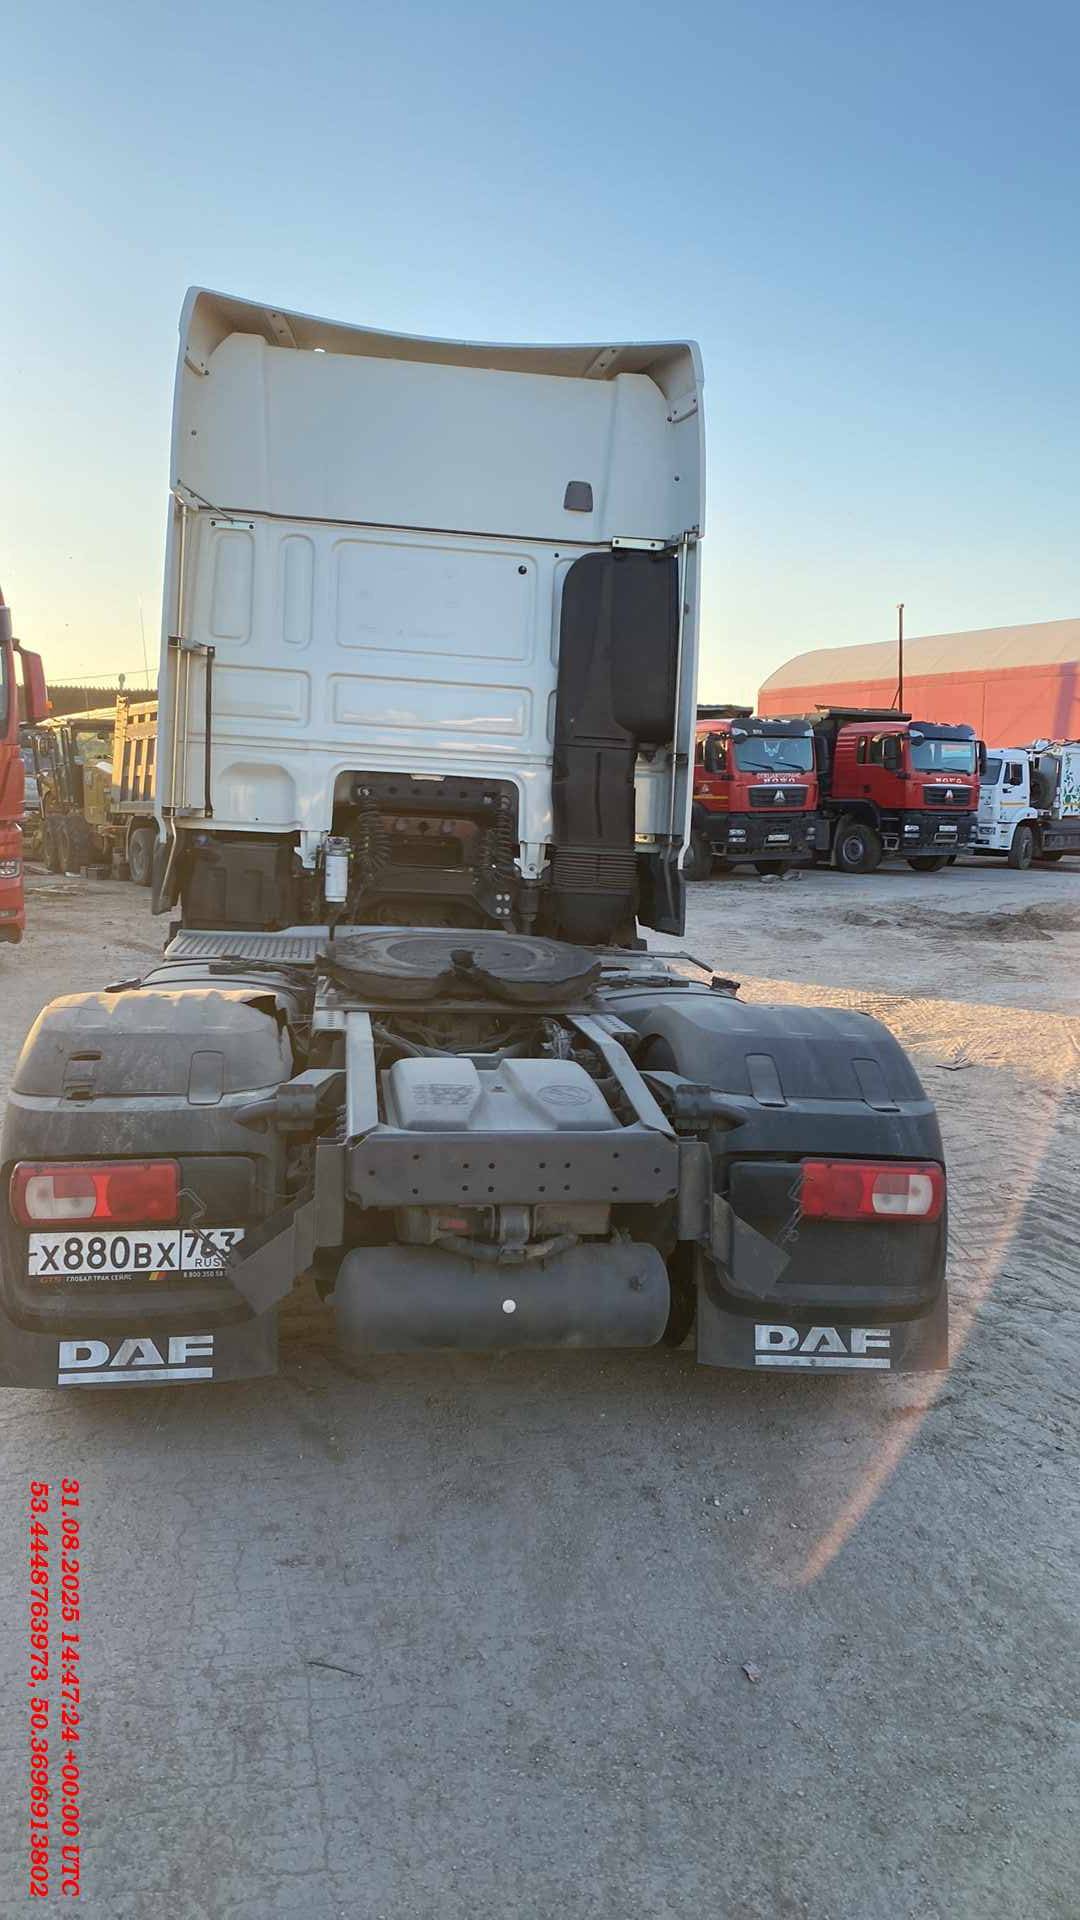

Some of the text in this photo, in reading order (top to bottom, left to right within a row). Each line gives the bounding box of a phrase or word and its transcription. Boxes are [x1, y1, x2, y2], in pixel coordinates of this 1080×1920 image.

[195, 1258, 222, 1268] RUS
[58, 1335, 214, 1369] DAF
[756, 1324, 891, 1353] DAF
